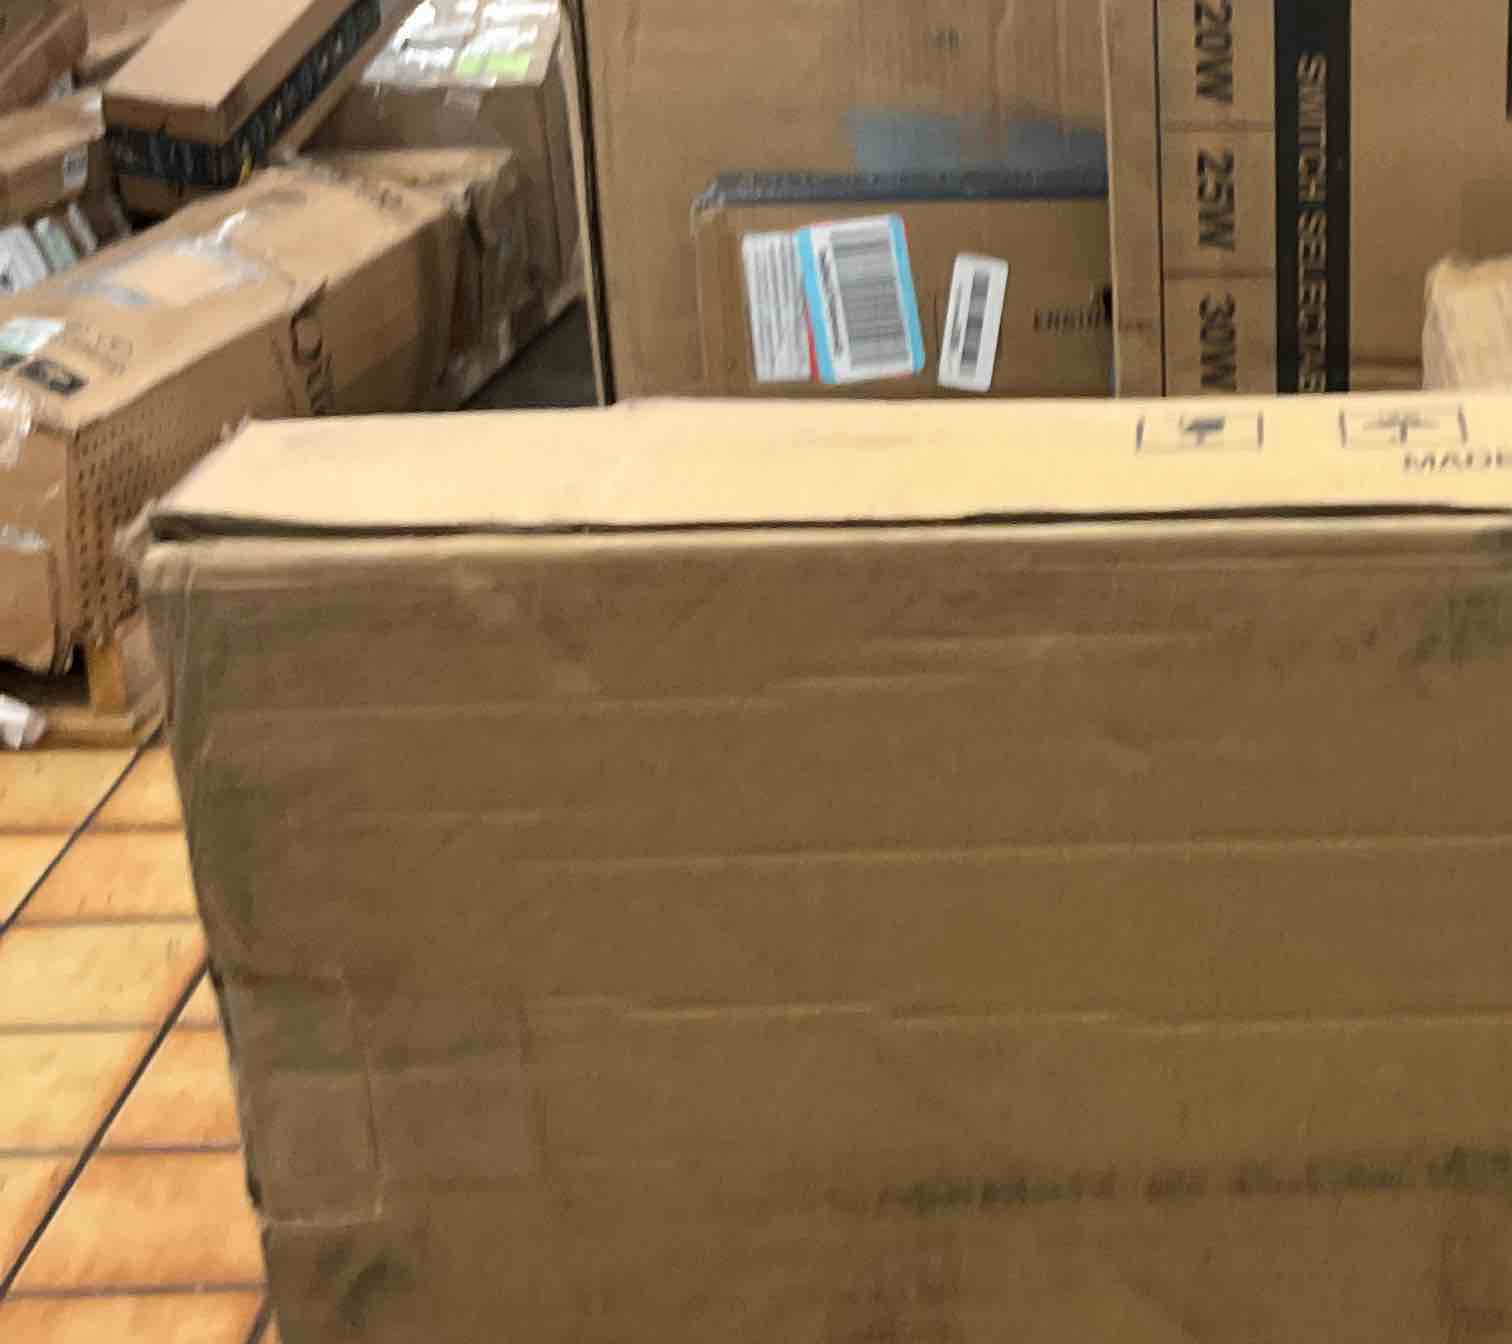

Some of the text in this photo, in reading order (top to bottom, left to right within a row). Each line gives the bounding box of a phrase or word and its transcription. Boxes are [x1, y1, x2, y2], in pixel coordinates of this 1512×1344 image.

[1296, 52, 1328, 201] SWITCH
[1196, 149, 1236, 253] 25W
[1199, 292, 1239, 392] 30W
